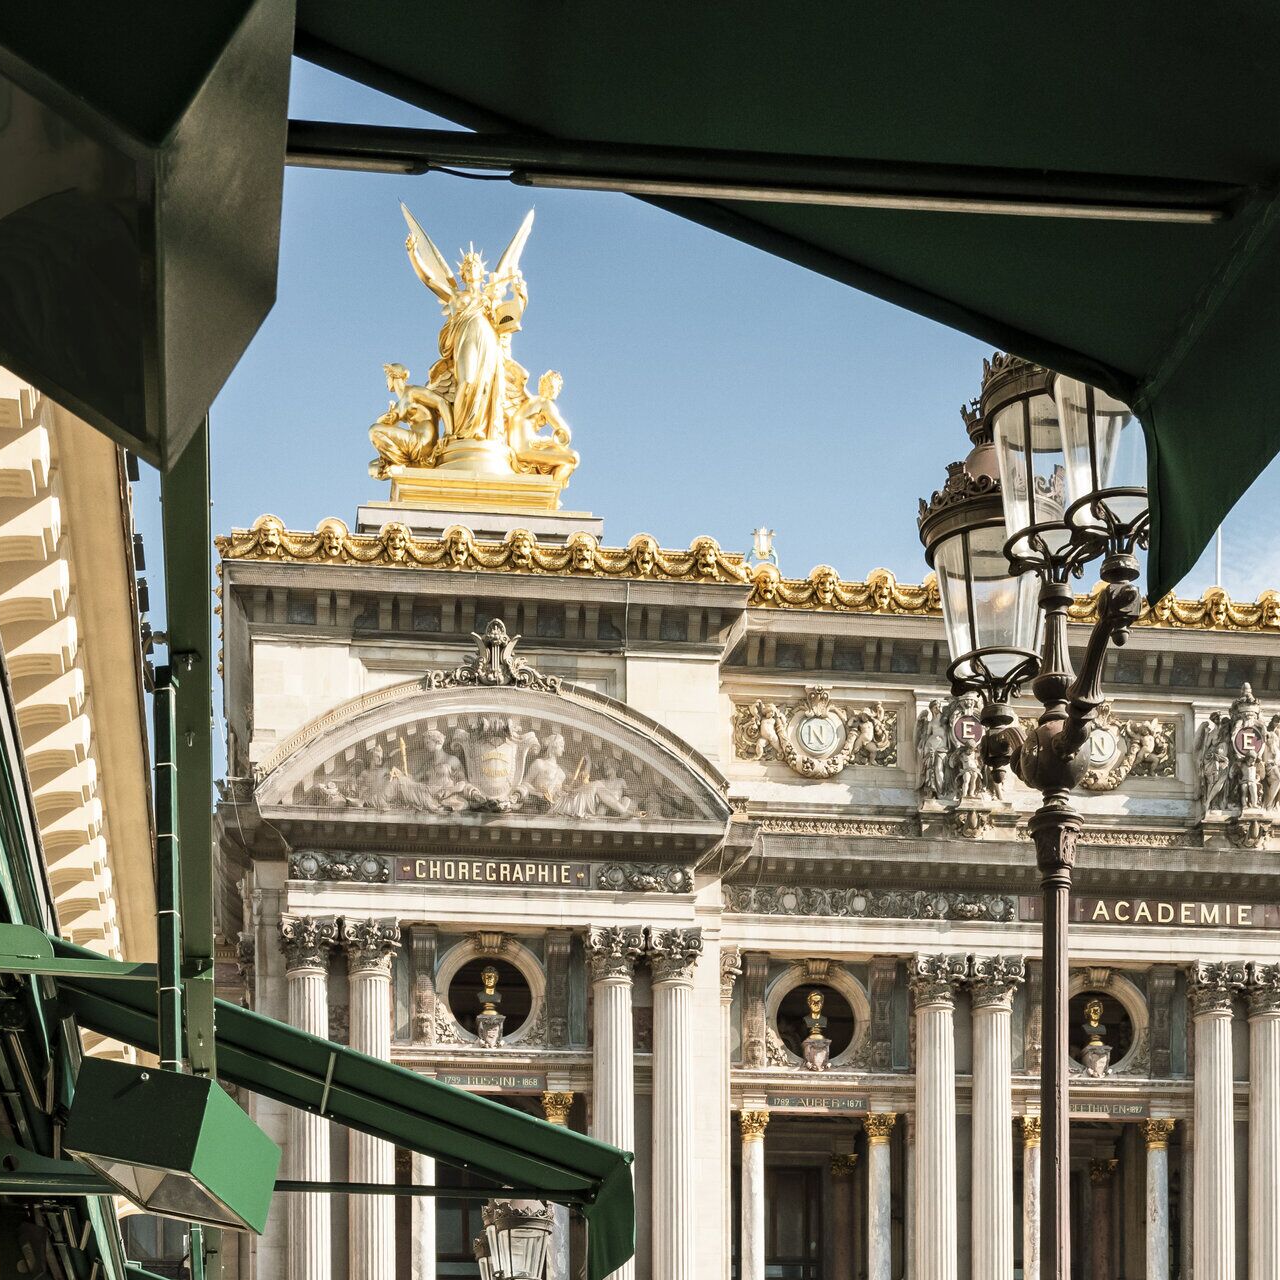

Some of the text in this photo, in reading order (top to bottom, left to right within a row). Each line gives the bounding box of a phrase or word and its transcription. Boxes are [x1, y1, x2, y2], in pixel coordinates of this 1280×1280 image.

[808, 725, 825, 745] N
[962, 721, 977, 739] E
[1241, 733, 1256, 750] E
[415, 859, 571, 883] CHOREGRAPHIE
[1092, 900, 1253, 925] ACADEMIE
[467, 1076, 516, 1087] ROSSINI
[797, 1097, 840, 1108] AUBER
